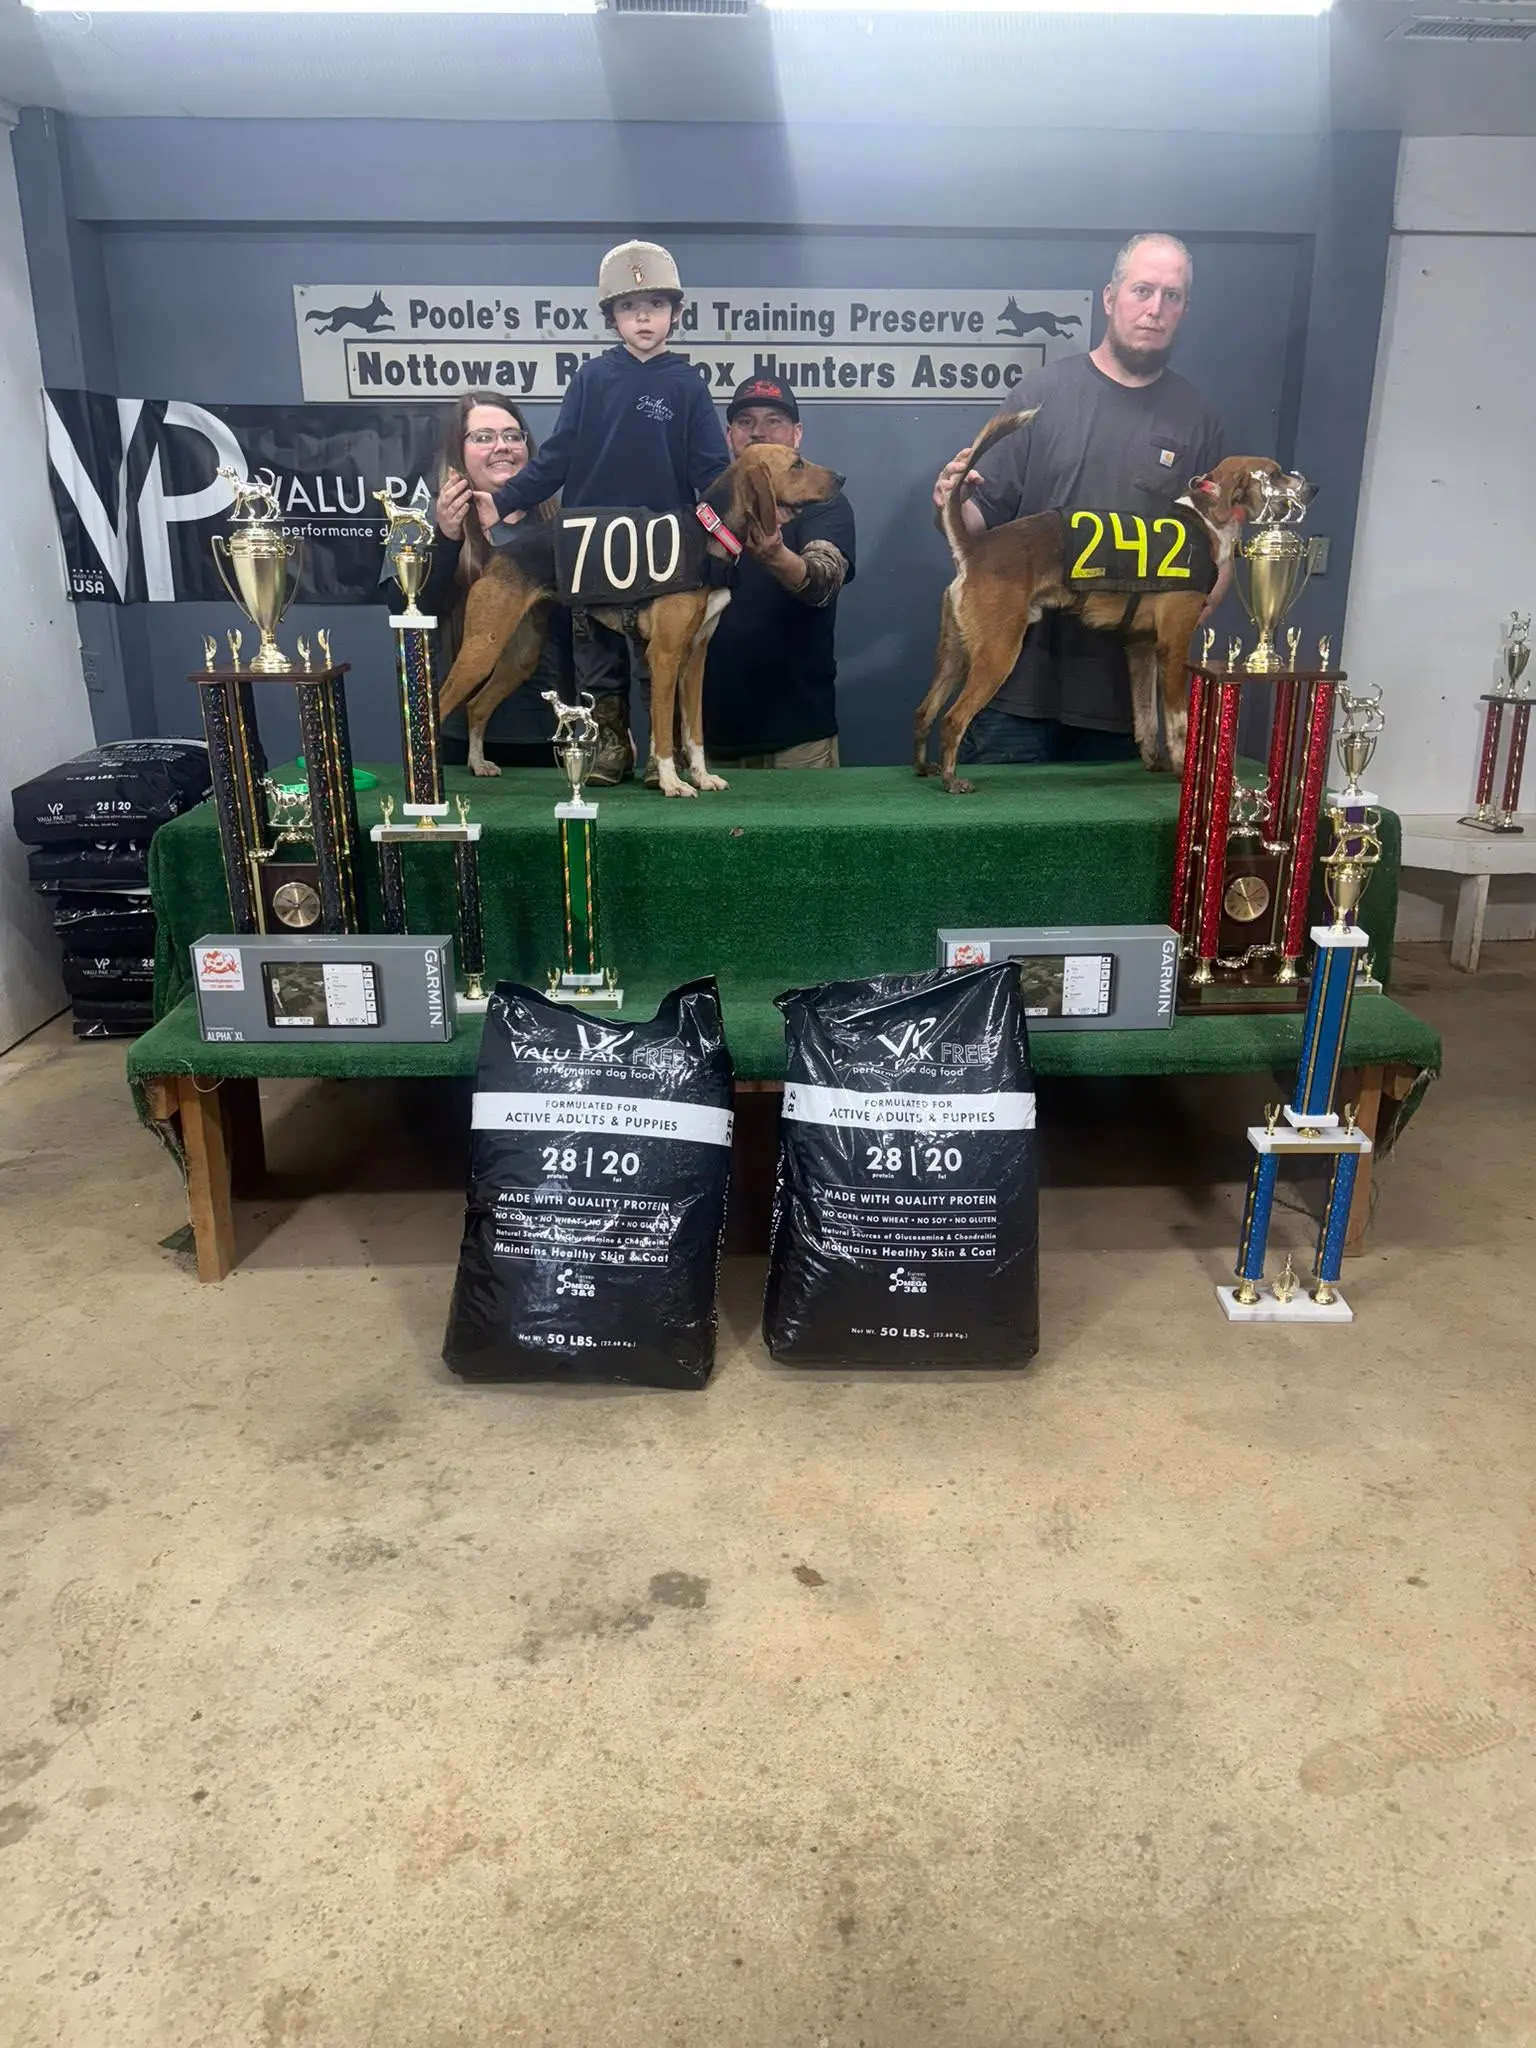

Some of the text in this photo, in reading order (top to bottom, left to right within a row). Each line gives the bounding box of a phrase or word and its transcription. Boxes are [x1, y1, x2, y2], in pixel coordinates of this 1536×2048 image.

[410, 299, 520, 330] Poole's
[535, 300, 589, 330] Fox
[713, 302, 835, 337] Training
[850, 303, 984, 333] Preserve
[357, 351, 537, 393] Nottoway
[674, 353, 735, 387] ox
[753, 353, 895, 388] Hunters
[912, 354, 1023, 389] Assoc
[42, 387, 248, 602] VP
[281, 523, 373, 537] performance
[1070, 511, 1190, 579] 242
[563, 514, 680, 594] 700
[73, 579, 105, 594] USA
[47, 803, 64, 815] VP
[96, 802, 131, 811] 28 20
[94, 958, 111, 970] VP
[142, 958, 155, 967] 28
[1157, 940, 1175, 1013] GARMIN
[424, 949, 443, 1025] GARMIN
[234, 1031, 245, 1041] XL
[877, 1017, 937, 1057] VP
[511, 1041, 570, 1062] VALU
[941, 1042, 990, 1064] FREE
[606, 1068, 627, 1080] dog
[631, 1070, 655, 1080] food
[919, 1065, 937, 1077] dog
[940, 1067, 965, 1076] food
[545, 1100, 638, 1112] FORMULATED FOR
[864, 1099, 928, 1109] FORMULATED
[505, 1112, 678, 1131] ACTIVE ADULTS & PUPPIES
[829, 1108, 870, 1122] ACTIVE
[541, 1147, 640, 1176] 28 20
[866, 1146, 962, 1172] 28 20
[498, 1193, 670, 1212] MADE WITH QUALITY PROTEIN
[824, 1189, 997, 1206] MADE WITH QUALITY PROTEIN
[495, 1211, 506, 1219] NO
[822, 1210, 835, 1218] NO
[837, 1212, 859, 1221] CORN
[866, 1215, 880, 1223] NO
[882, 1216, 909, 1224] WHEAT
[821, 1226, 850, 1236] Natural
[884, 1232, 892, 1240] of
[895, 1233, 944, 1241] Glucosamine
[954, 1233, 997, 1241] Chondroitin
[494, 1242, 547, 1256] Maintains
[551, 1247, 596, 1261] Healthy
[643, 1252, 669, 1263] Coat
[882, 1247, 927, 1259] Healthy
[931, 1248, 955, 1257] Skin
[959, 1248, 967, 1257] &
[971, 1247, 996, 1257] Coat
[564, 1281, 596, 1290] OMEGA
[896, 1279, 928, 1287] OMEGA
[571, 1289, 595, 1297] 3&6
[880, 1327, 898, 1337] 50
[903, 1328, 930, 1338] LBS.
[547, 1333, 565, 1345] 50
[570, 1335, 598, 1347] LBS.
